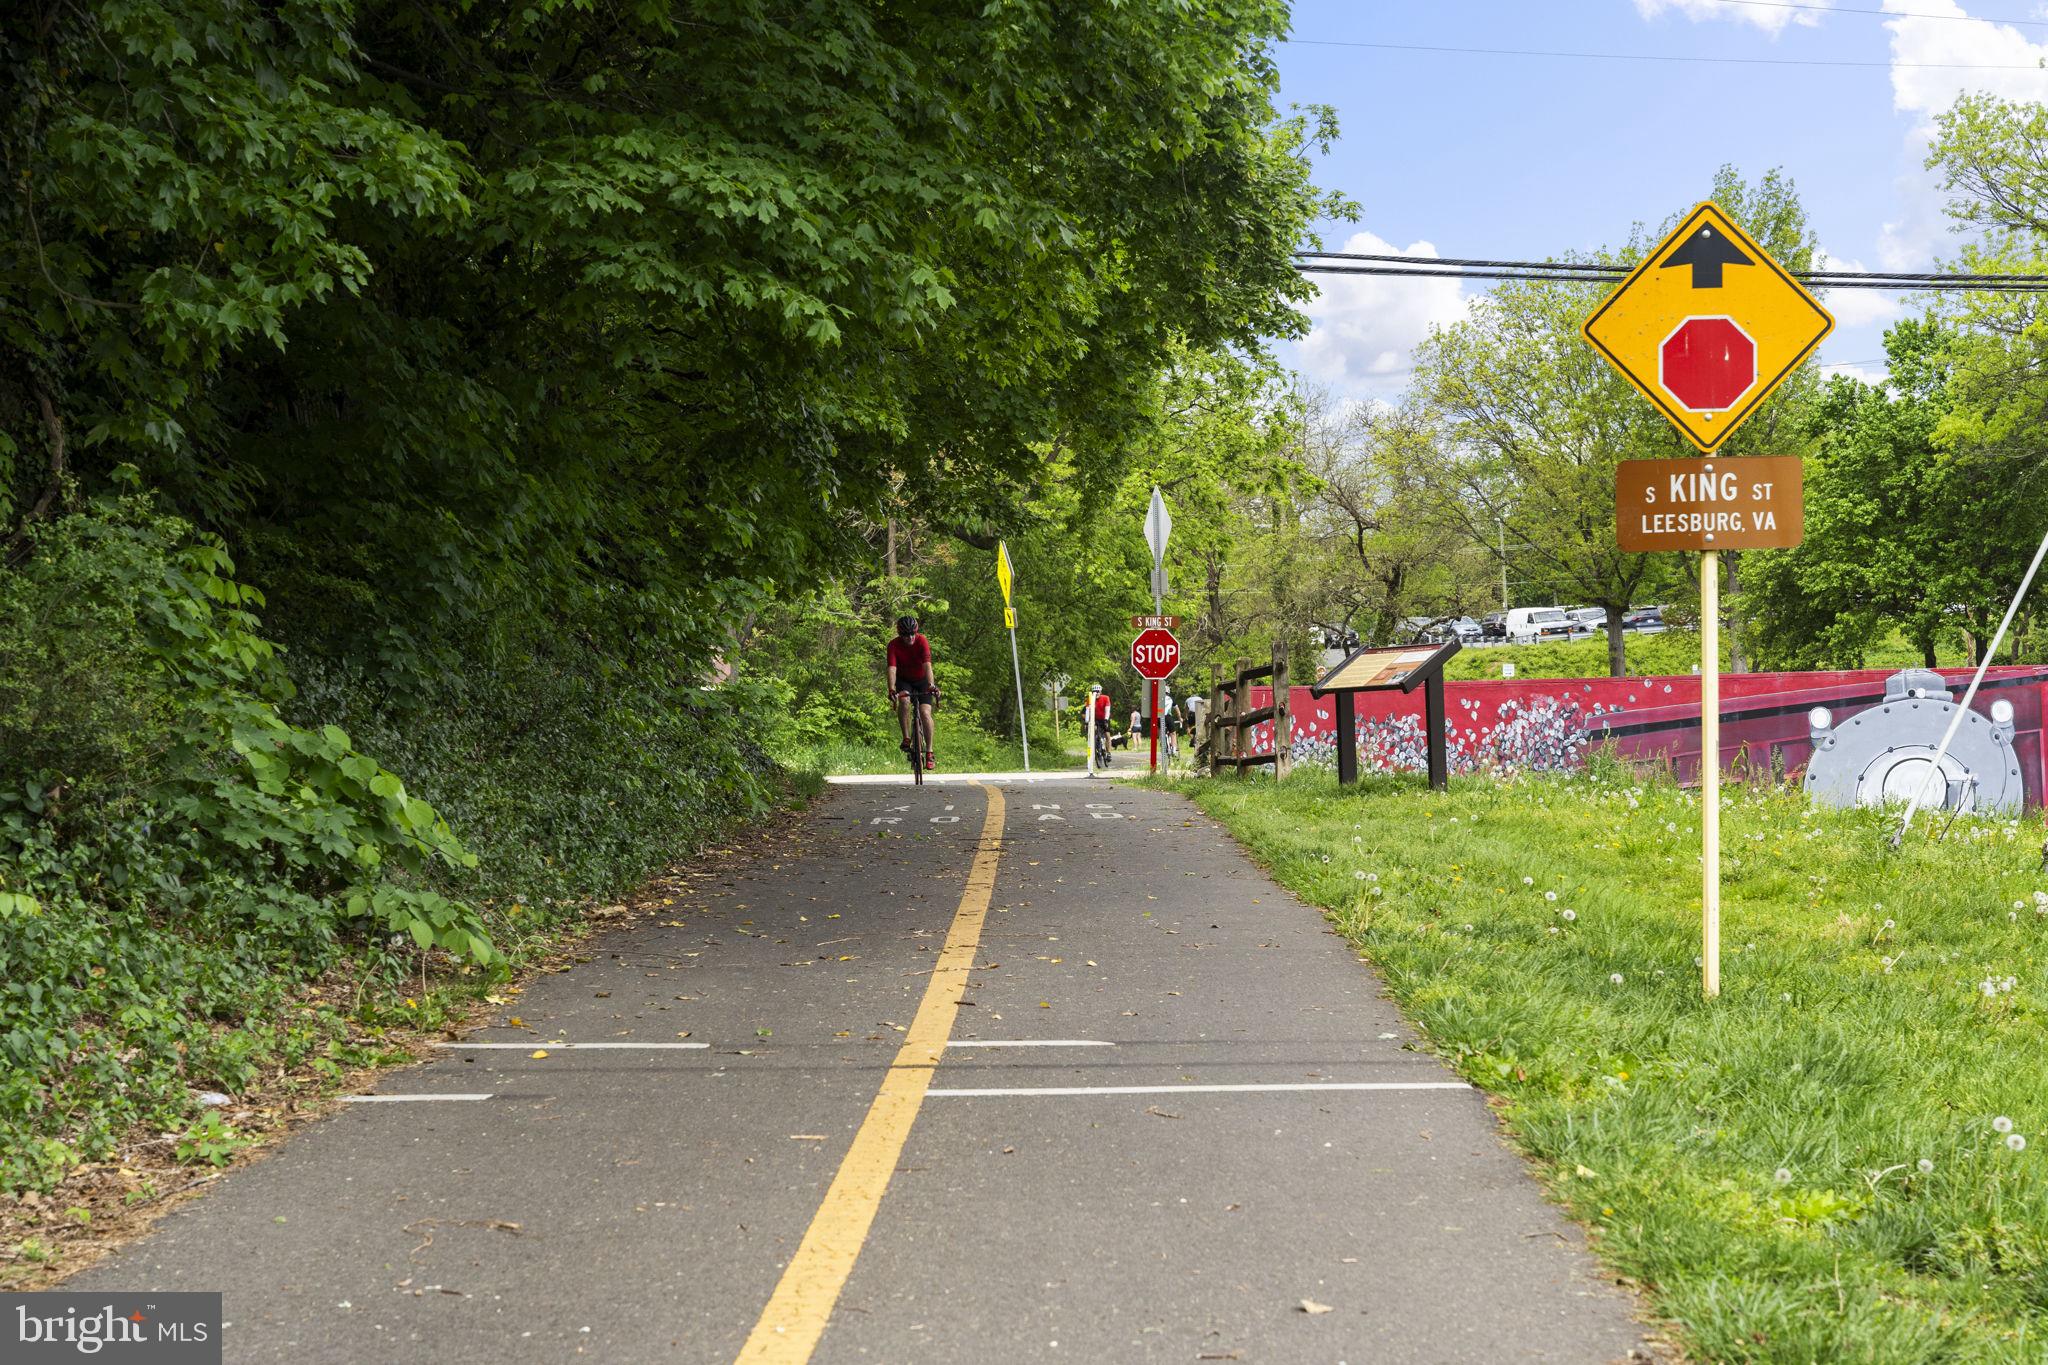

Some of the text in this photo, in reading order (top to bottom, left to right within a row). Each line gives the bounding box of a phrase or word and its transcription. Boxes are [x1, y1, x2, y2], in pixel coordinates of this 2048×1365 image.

[1645, 472, 1773, 503] S KING ST
[1642, 512, 1776, 533] LEESBURG, VA
[1137, 617, 1172, 627] S KING ST
[1135, 645, 1176, 663] STOP
[870, 812, 1124, 825] ROAD
